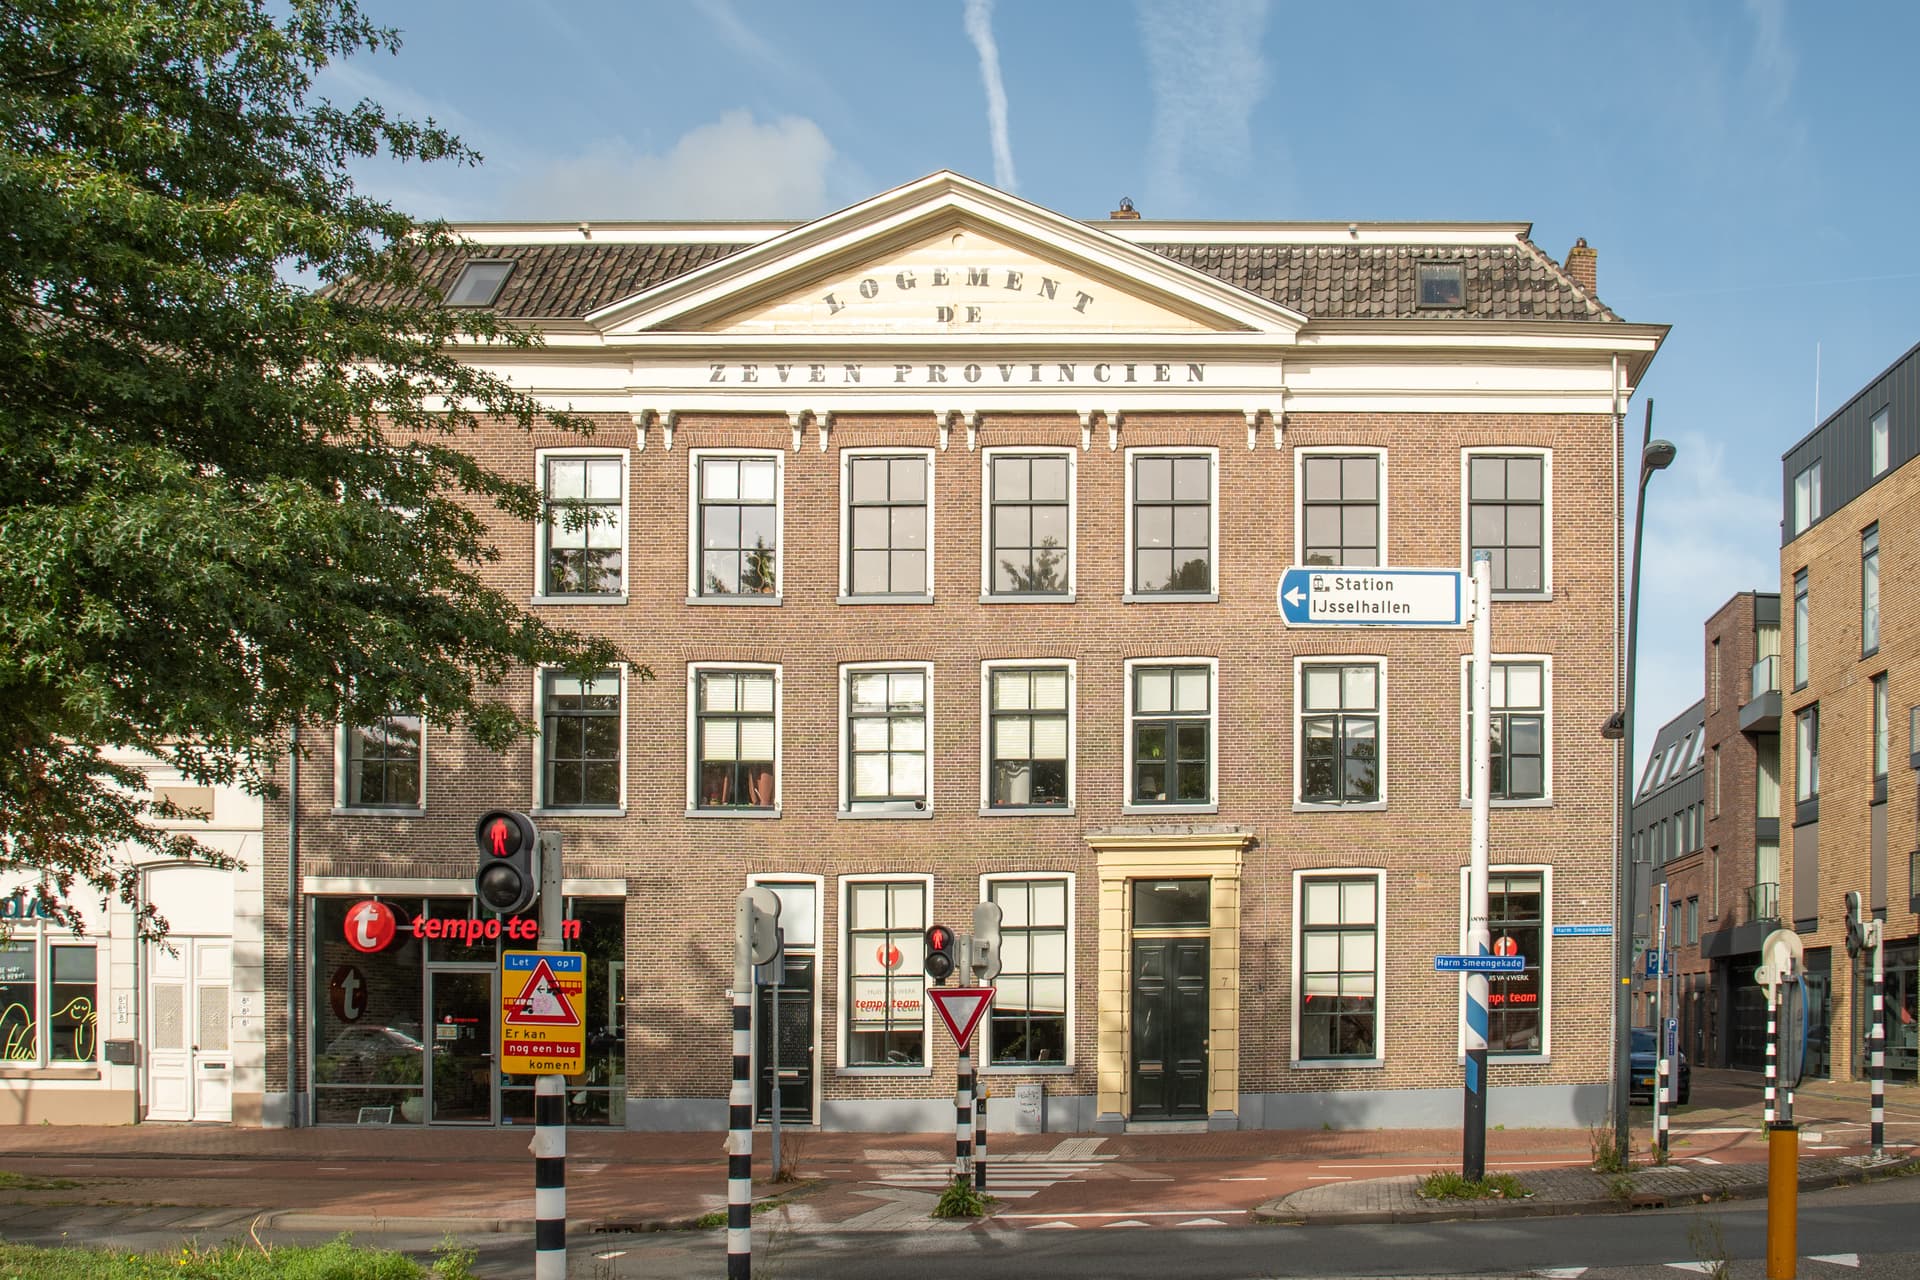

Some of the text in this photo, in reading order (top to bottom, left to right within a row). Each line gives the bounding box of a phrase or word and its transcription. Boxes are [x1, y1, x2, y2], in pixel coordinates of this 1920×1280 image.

[823, 266, 1094, 316] LOGEMENT
[936, 306, 982, 323] DE
[709, 363, 1206, 383] ZEVEN PROVINCIEN
[1335, 577, 1394, 591] Station
[1312, 600, 1411, 614] IJsselhallen
[412, 913, 581, 947] tempo tem
[512, 957, 575, 968] Let op!
[1437, 958, 1522, 969] Harm Smeengekade
[1509, 993, 1537, 1002] team
[892, 1000, 920, 1009] team
[1669, 1020, 1676, 1030] P
[505, 1028, 546, 1039] Er kan
[509, 1044, 576, 1055] nog een bus
[529, 1060, 577, 1069] komen!
